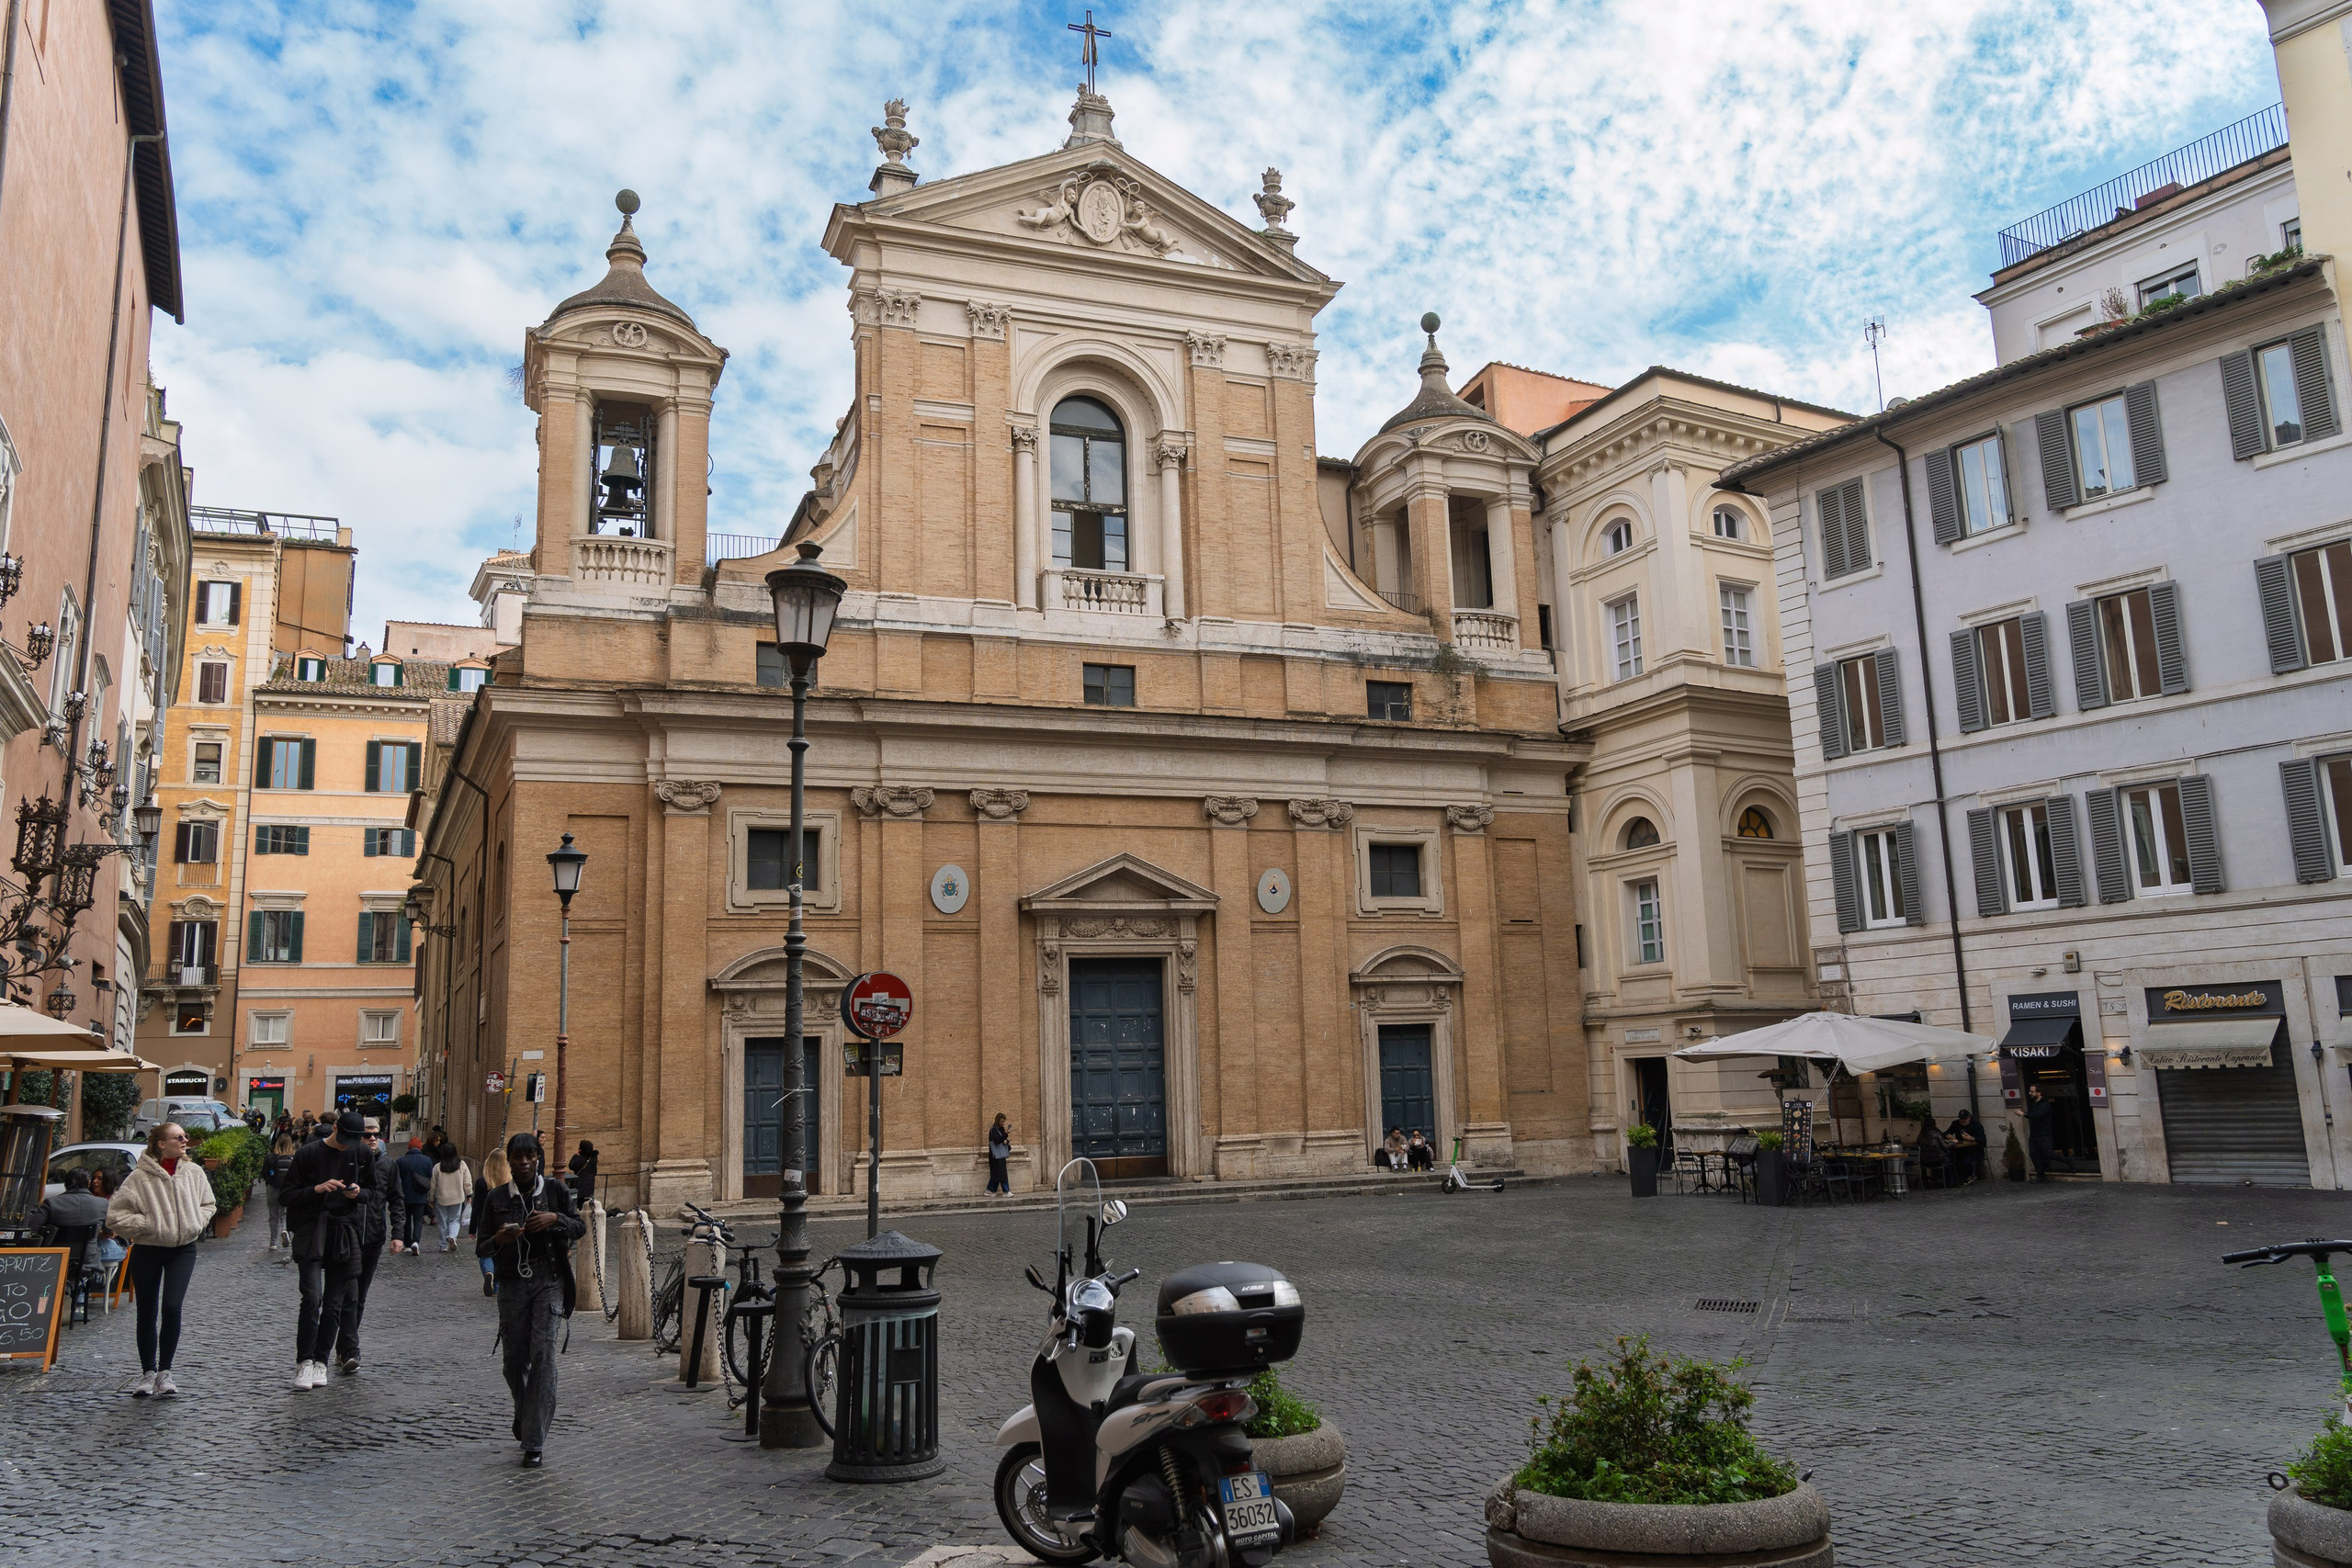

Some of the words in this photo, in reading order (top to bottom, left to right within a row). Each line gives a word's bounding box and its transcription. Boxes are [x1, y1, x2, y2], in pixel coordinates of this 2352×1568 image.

[2012, 1001, 2041, 1010] RAMEN
[2044, 1000, 2050, 1009] &
[2051, 998, 2076, 1008] SUSHI
[2164, 989, 2267, 1010] Ristorante
[2010, 1046, 2050, 1057] KISAKI
[2143, 1053, 2174, 1064] Antico
[2177, 1053, 2222, 1064] Ristorante
[2223, 1051, 2267, 1064] Capranica
[3, 1282, 28, 1296] TO
[1231, 1477, 1252, 1499] ES
[1227, 1502, 1275, 1529] 36032
[1235, 1536, 1252, 1544] MOTO
[1253, 1531, 1278, 1540] CAPITAL
